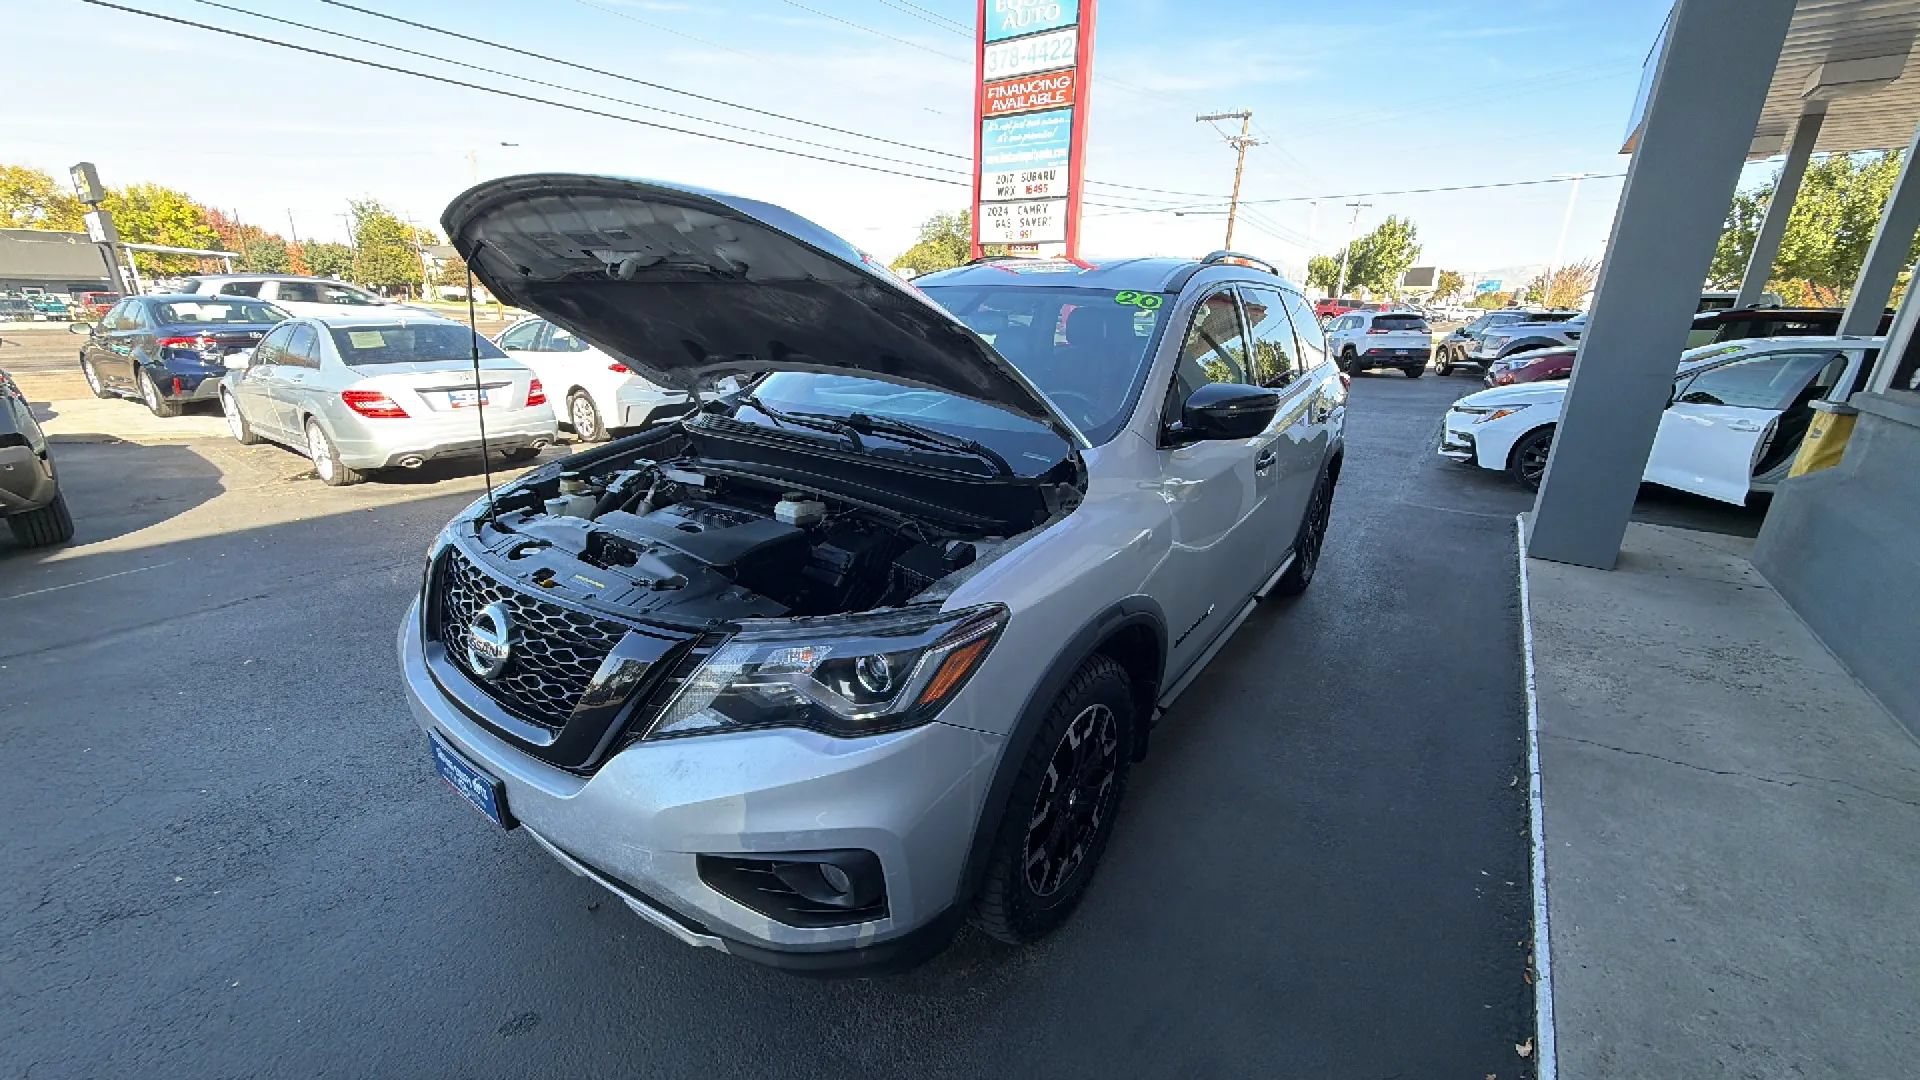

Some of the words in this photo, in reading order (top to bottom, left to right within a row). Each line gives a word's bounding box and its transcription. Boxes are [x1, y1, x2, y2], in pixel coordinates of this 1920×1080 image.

[1002, 4, 1060, 30] AUTO
[988, 36, 1073, 72] 378-4422
[987, 76, 1071, 98] FINANCING
[991, 90, 1067, 111] AVAILABLE
[996, 173, 1014, 184] 2017
[1021, 170, 1056, 182] SUBARU
[997, 185, 1016, 196] WRX
[987, 206, 1008, 216] 2024
[1018, 203, 1048, 215] CAMRY
[996, 218, 1011, 228] GAS
[468, 637, 500, 658] SSAN
